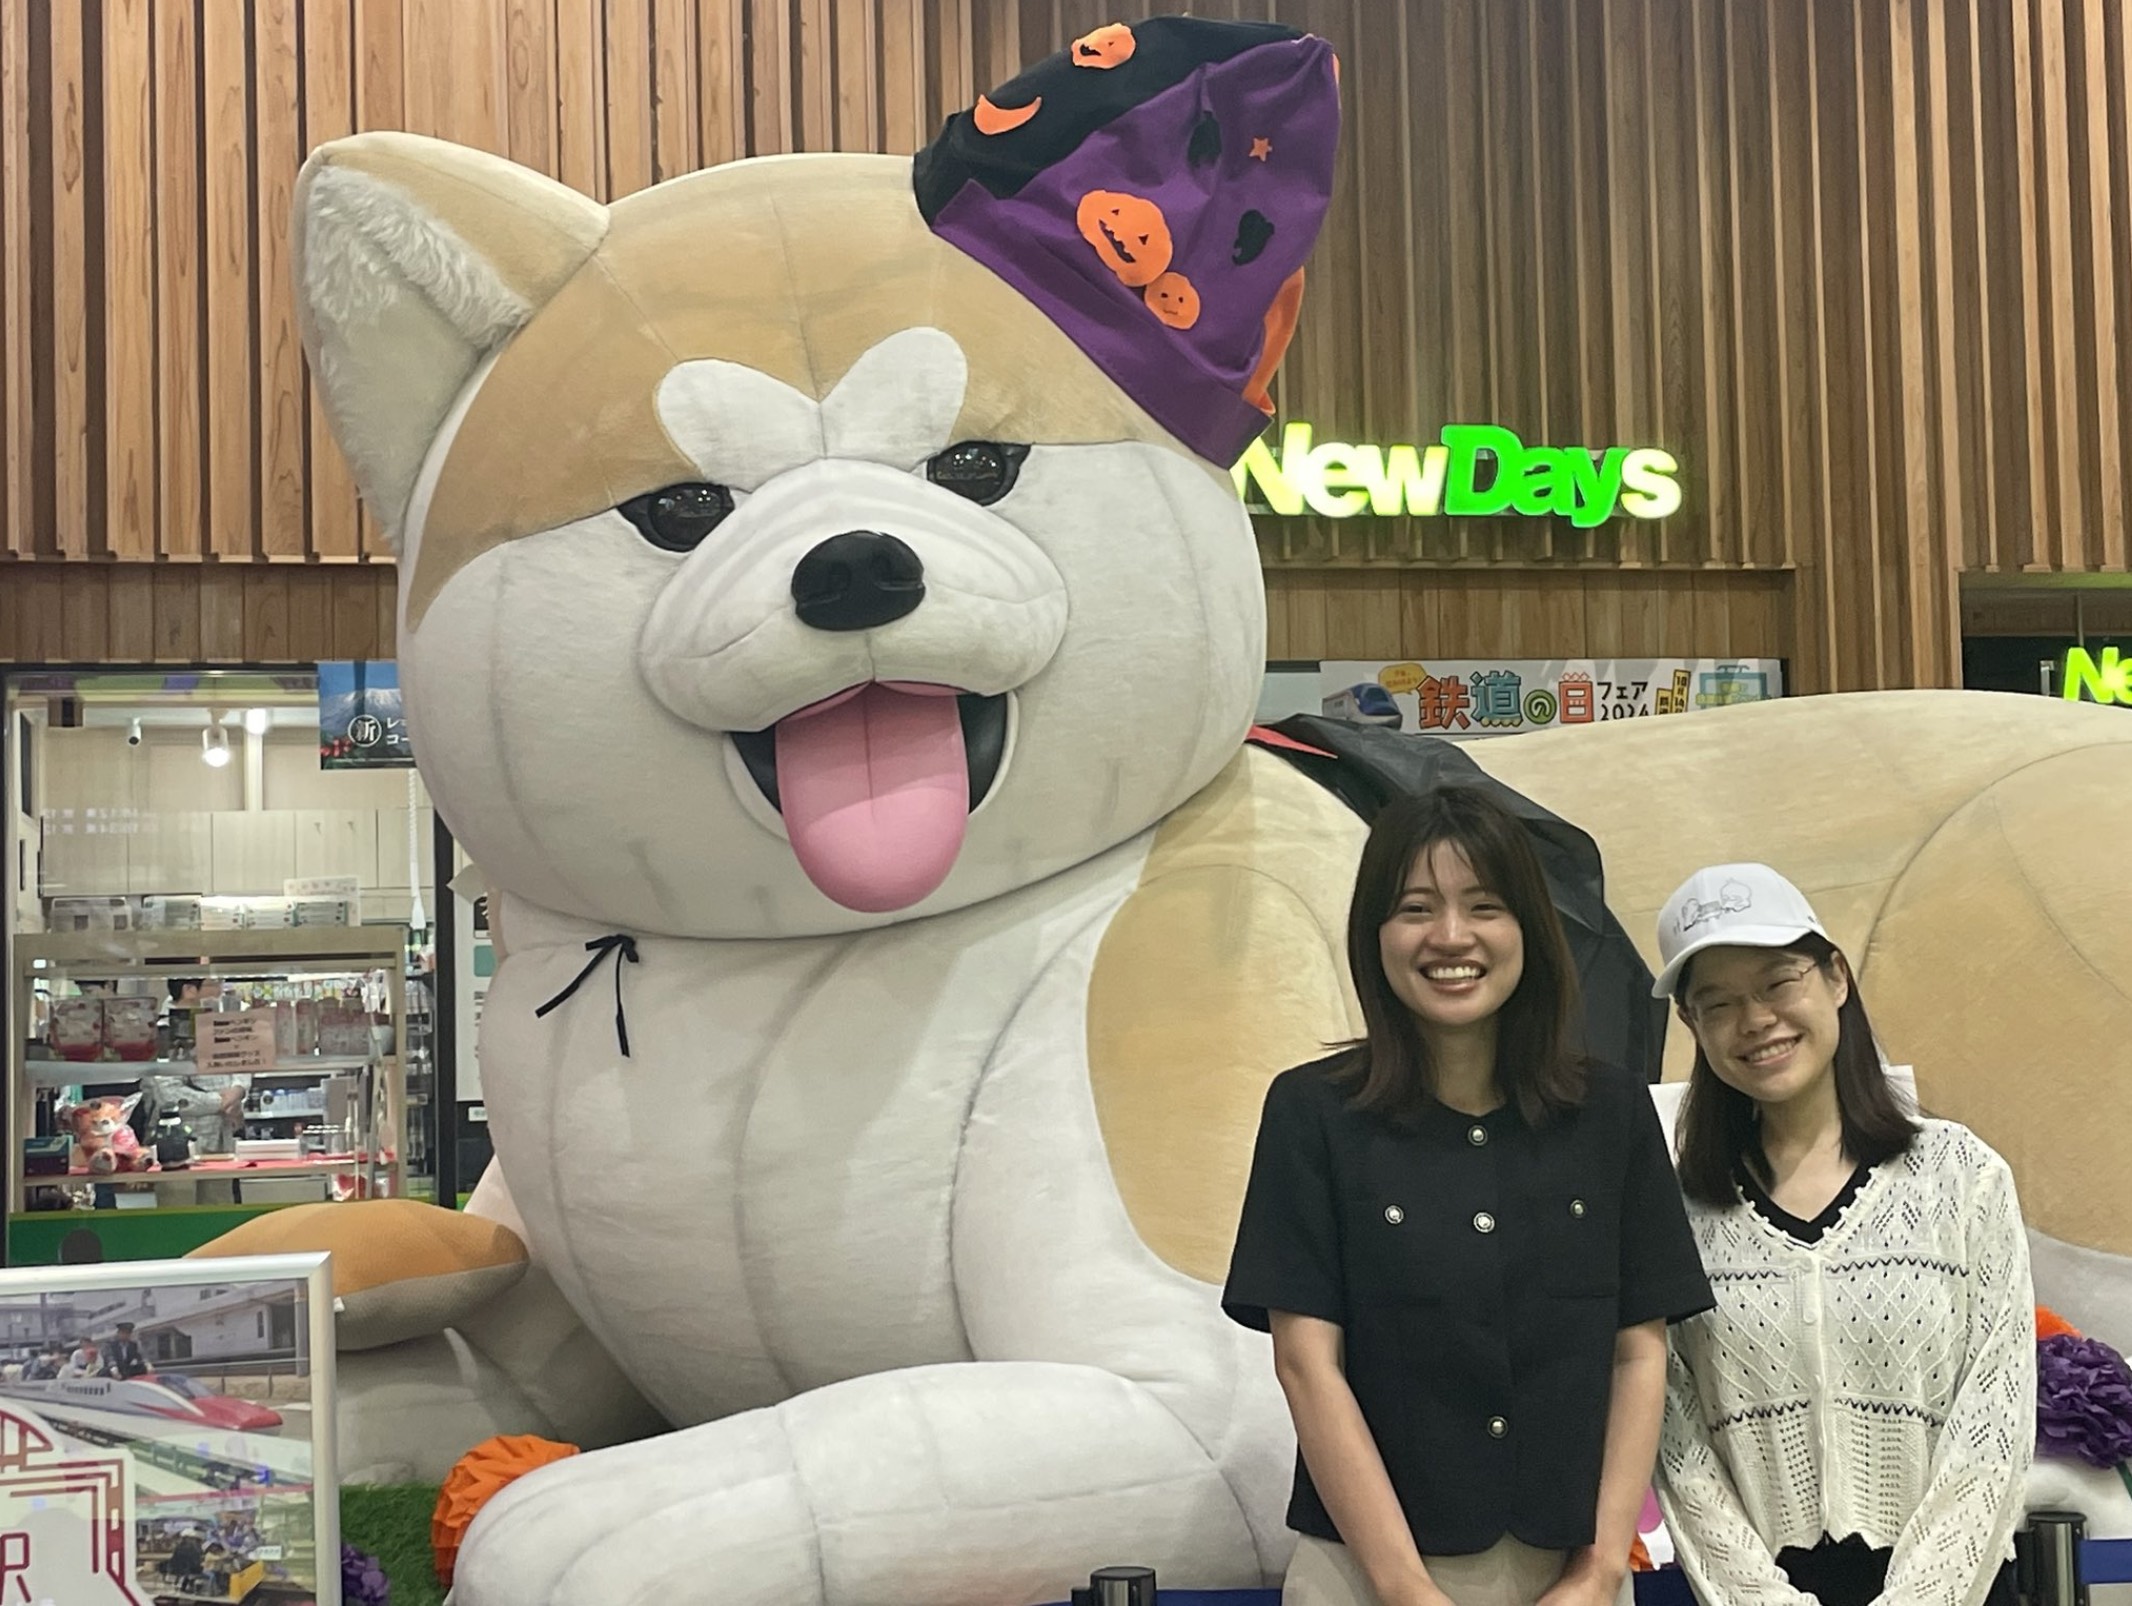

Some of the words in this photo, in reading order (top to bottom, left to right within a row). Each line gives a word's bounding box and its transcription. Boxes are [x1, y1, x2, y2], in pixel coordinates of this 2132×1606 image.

[1229, 422, 1682, 528] NewDays
[1416, 670, 1595, 730] 鉄道の日
[1597, 682, 1648, 700] フェア
[1600, 704, 1649, 722] 2024
[356, 719, 378, 742] 新
